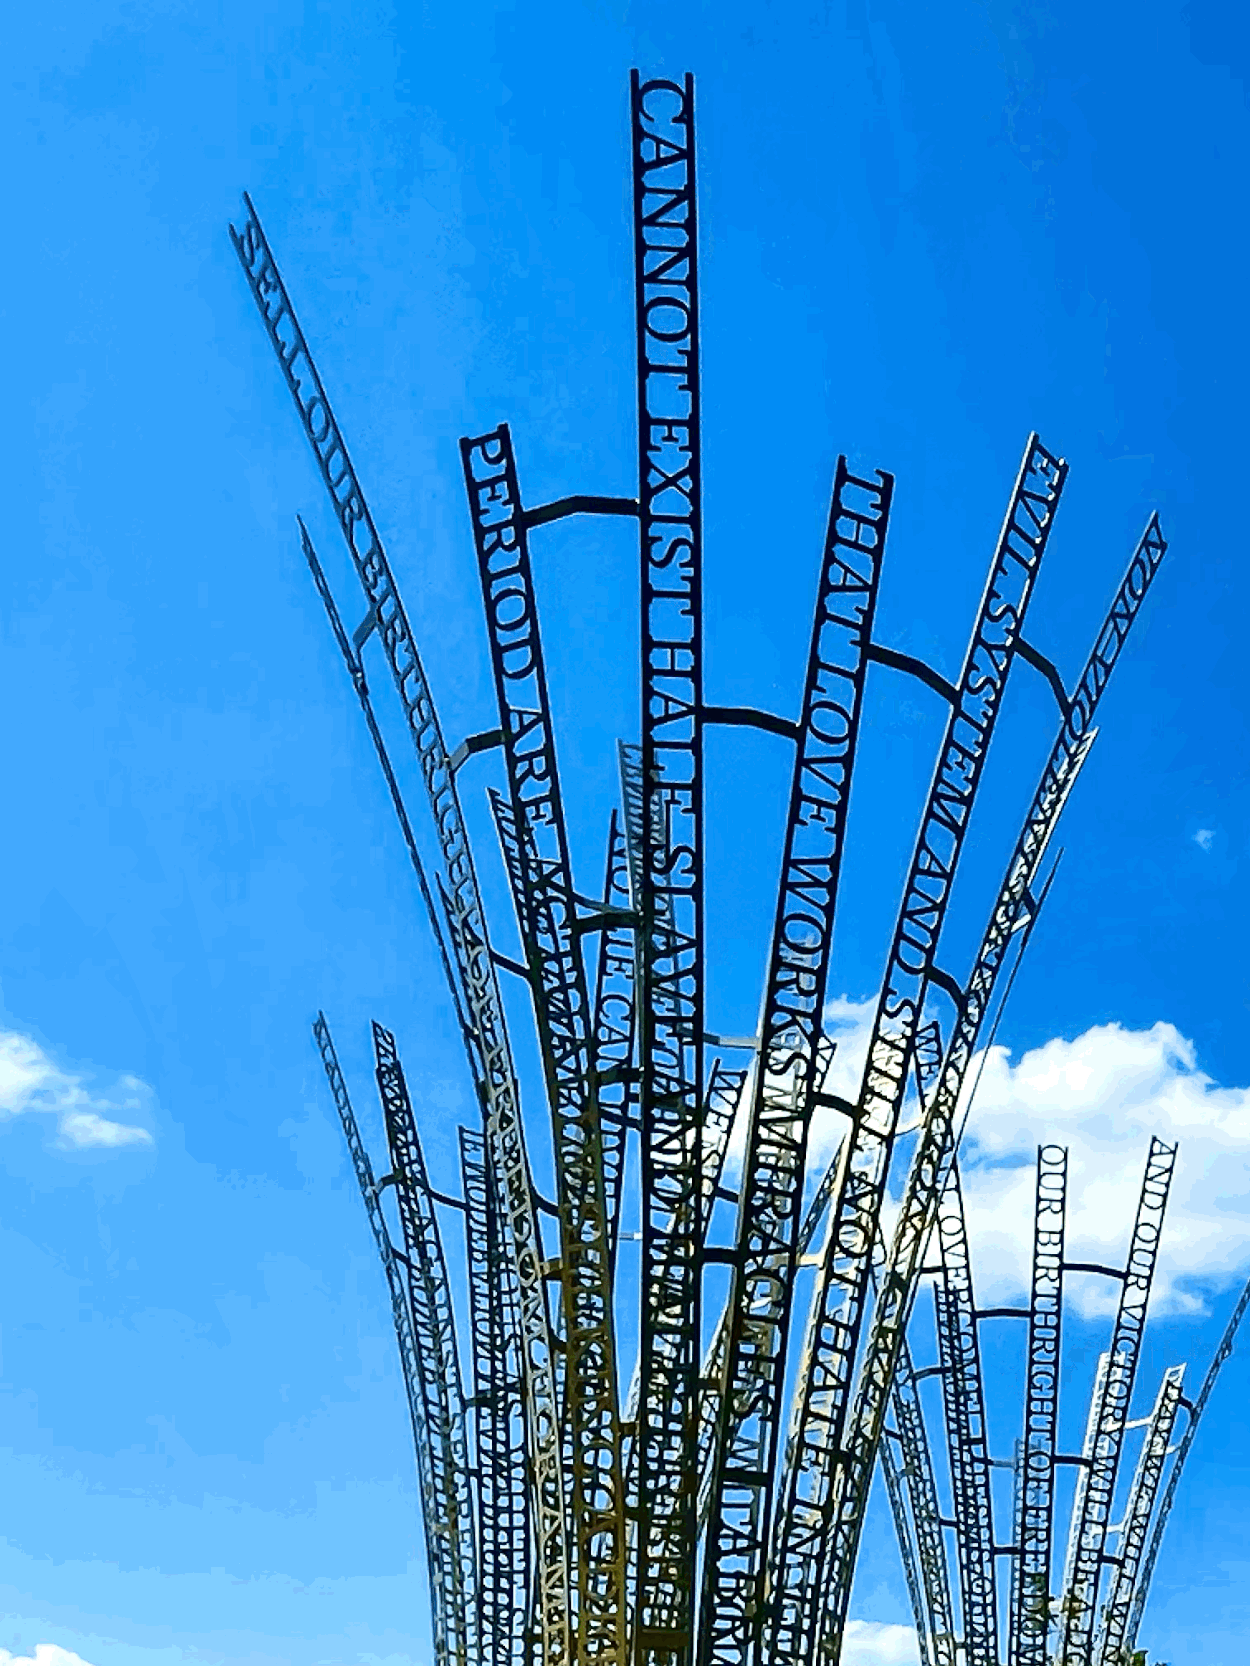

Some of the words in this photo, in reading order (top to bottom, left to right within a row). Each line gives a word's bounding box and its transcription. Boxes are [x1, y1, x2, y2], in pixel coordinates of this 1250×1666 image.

[634, 77, 699, 398] CANNOT
[303, 393, 368, 537] OUR
[642, 407, 701, 623] EXIST
[815, 456, 891, 646] THAT
[991, 437, 1071, 607] EVIL
[465, 431, 539, 681] PERIOD
[503, 700, 564, 834] ARE
[927, 595, 1022, 836] SYSTEM
[644, 637, 701, 818] HALF
[795, 654, 862, 833] LOVE
[644, 842, 701, 1045] SLAVE
[759, 849, 840, 1084] WORKS
[897, 849, 959, 985] AND
[1036, 1143, 1067, 1217] OUR
[1125, 1218, 1163, 1294] OUR
[1141, 1136, 1179, 1215] AND
[1026, 1228, 1063, 1441] BIRTHRIGHT
[1094, 1300, 1146, 1448] VICTORY
